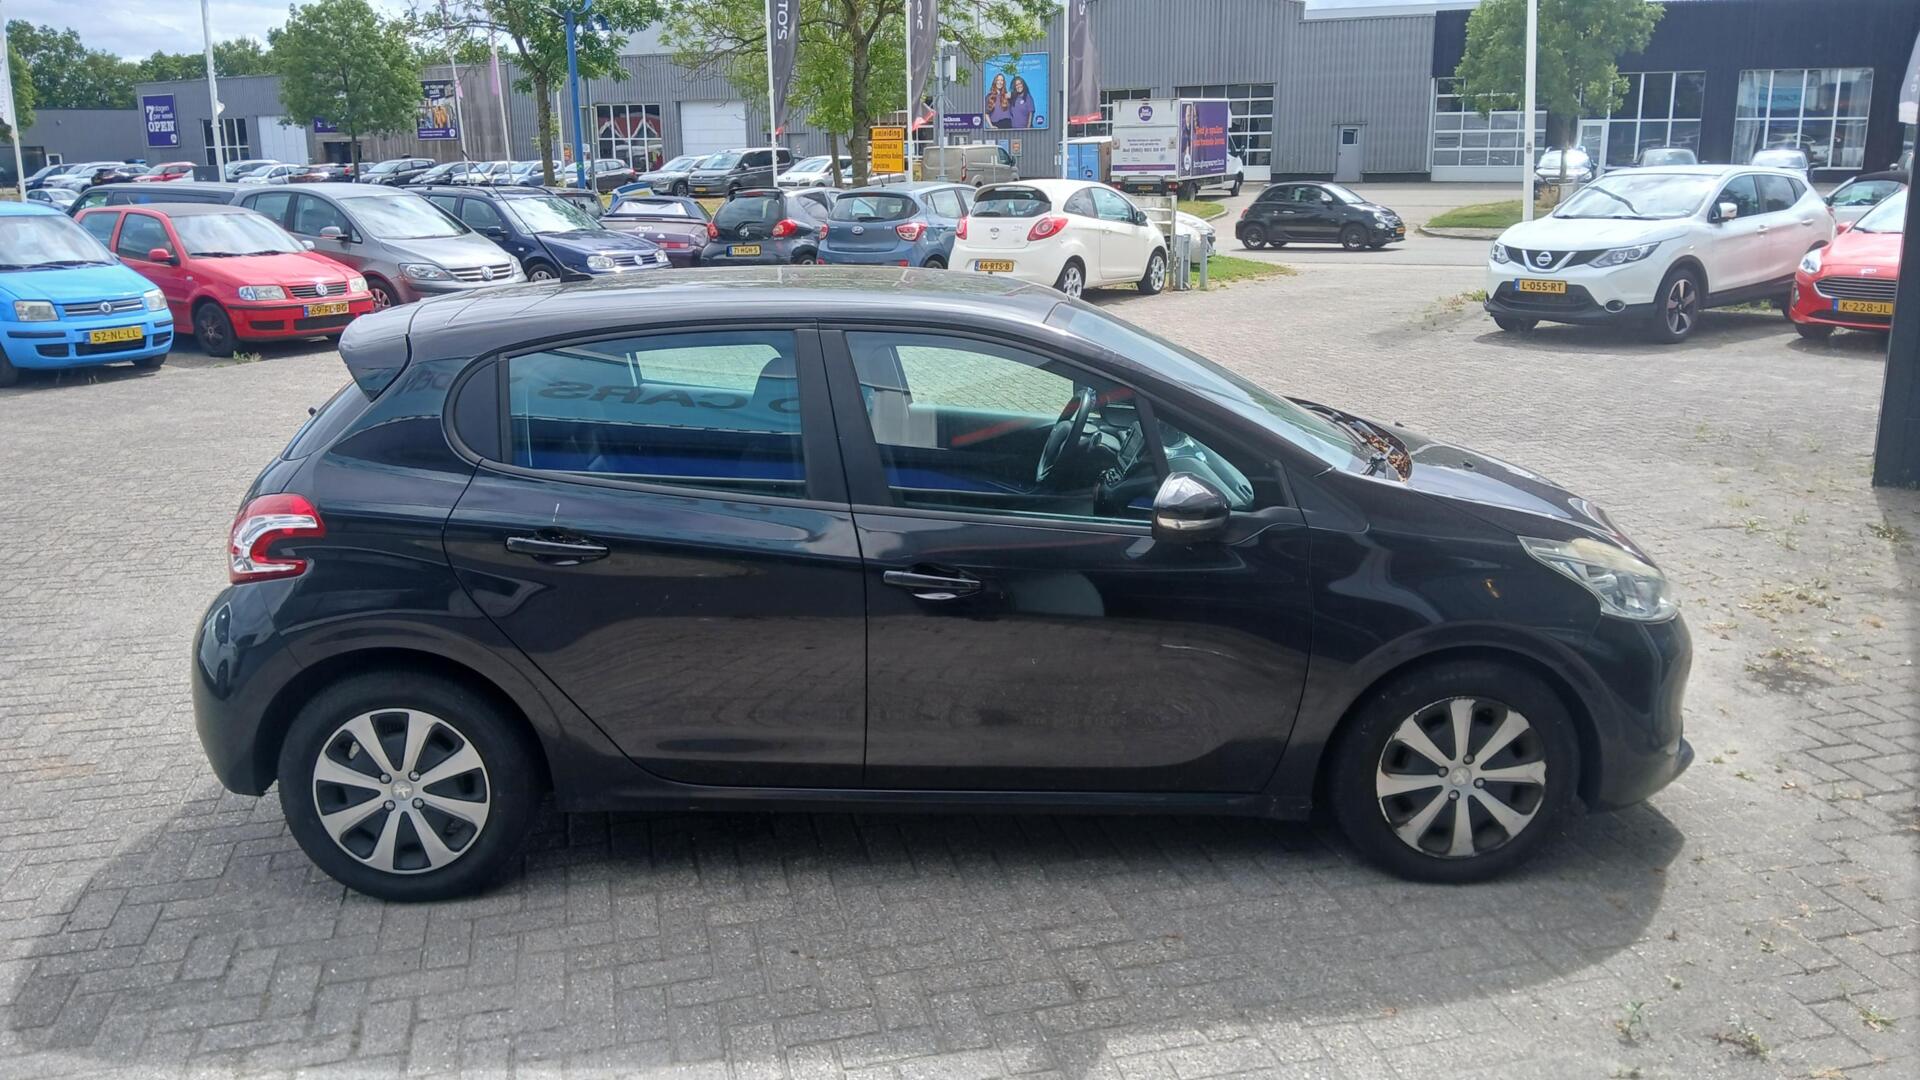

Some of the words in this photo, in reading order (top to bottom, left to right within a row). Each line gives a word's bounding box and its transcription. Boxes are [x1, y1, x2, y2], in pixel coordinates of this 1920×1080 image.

[145, 105, 154, 121] 7
[148, 121, 175, 132] OPEN
[1521, 280, 1563, 292] L-055-RT
[1841, 301, 1890, 314] K-228-JL
[93, 328, 139, 342] 52-NL-LL
